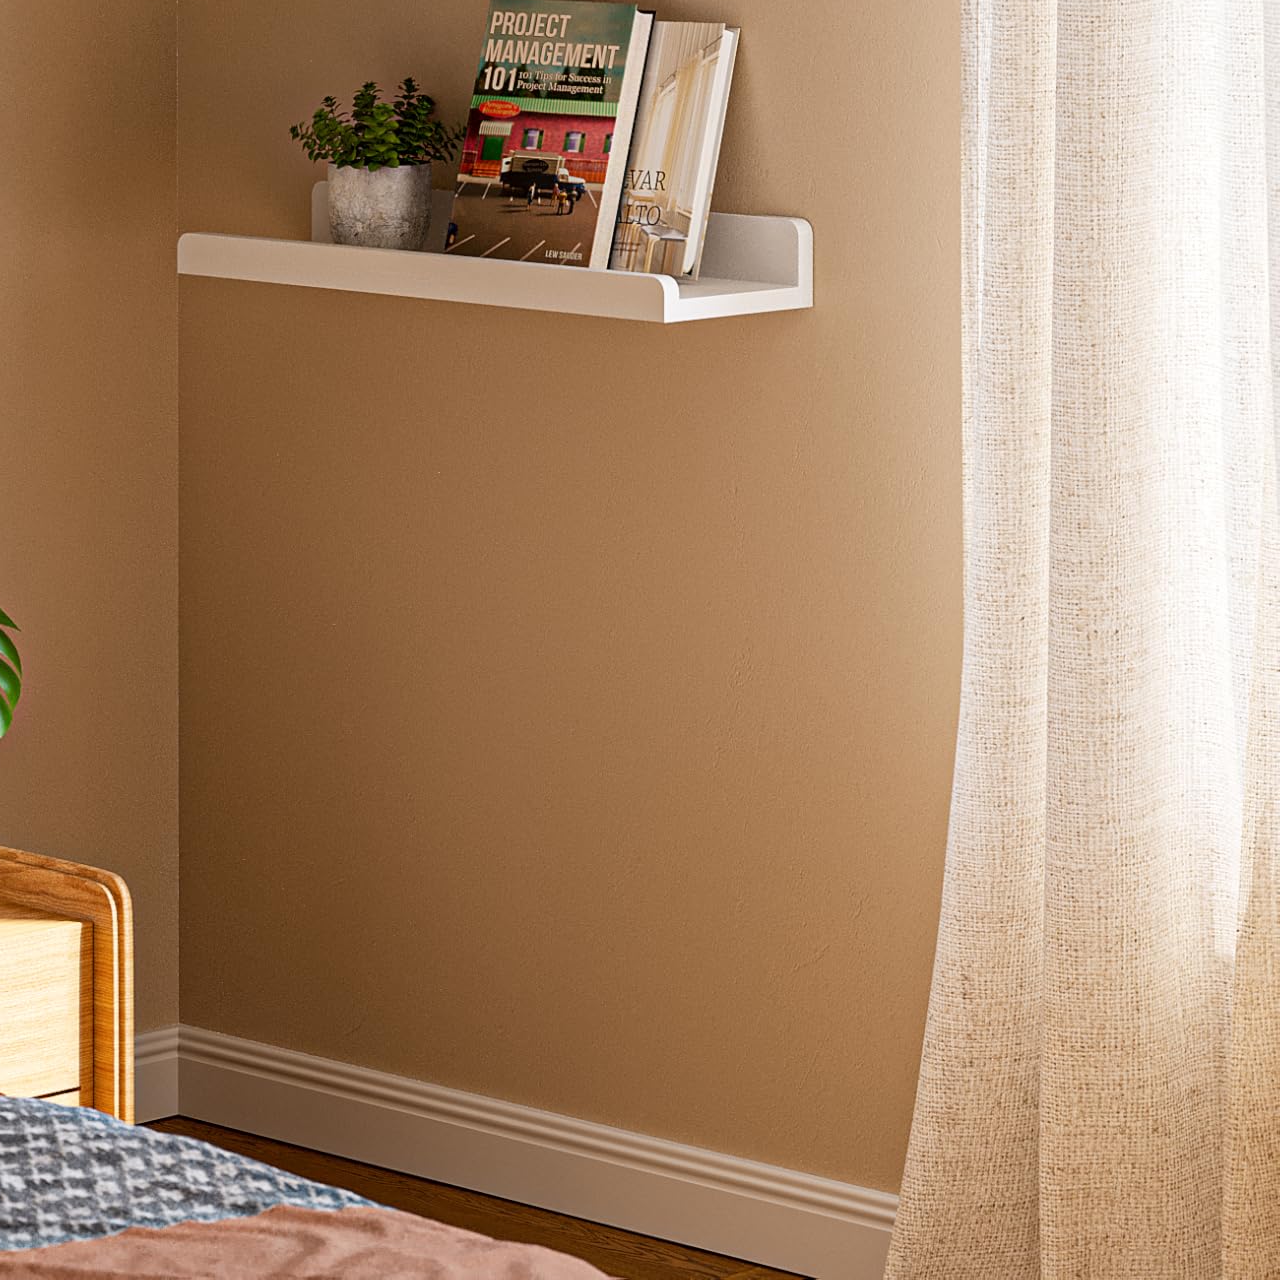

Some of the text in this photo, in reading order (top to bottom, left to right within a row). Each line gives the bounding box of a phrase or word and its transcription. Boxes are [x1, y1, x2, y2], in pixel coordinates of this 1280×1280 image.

[489, 11, 571, 38] PROJECT
[484, 39, 620, 69] MANAGEMENT
[483, 66, 517, 91] 101
[517, 80, 603, 95] Project Management
[518, 71, 612, 84] 101 Tips for Success in
[624, 169, 666, 191] VAR
[618, 204, 661, 225] LTO
[545, 249, 558, 258] LEW
